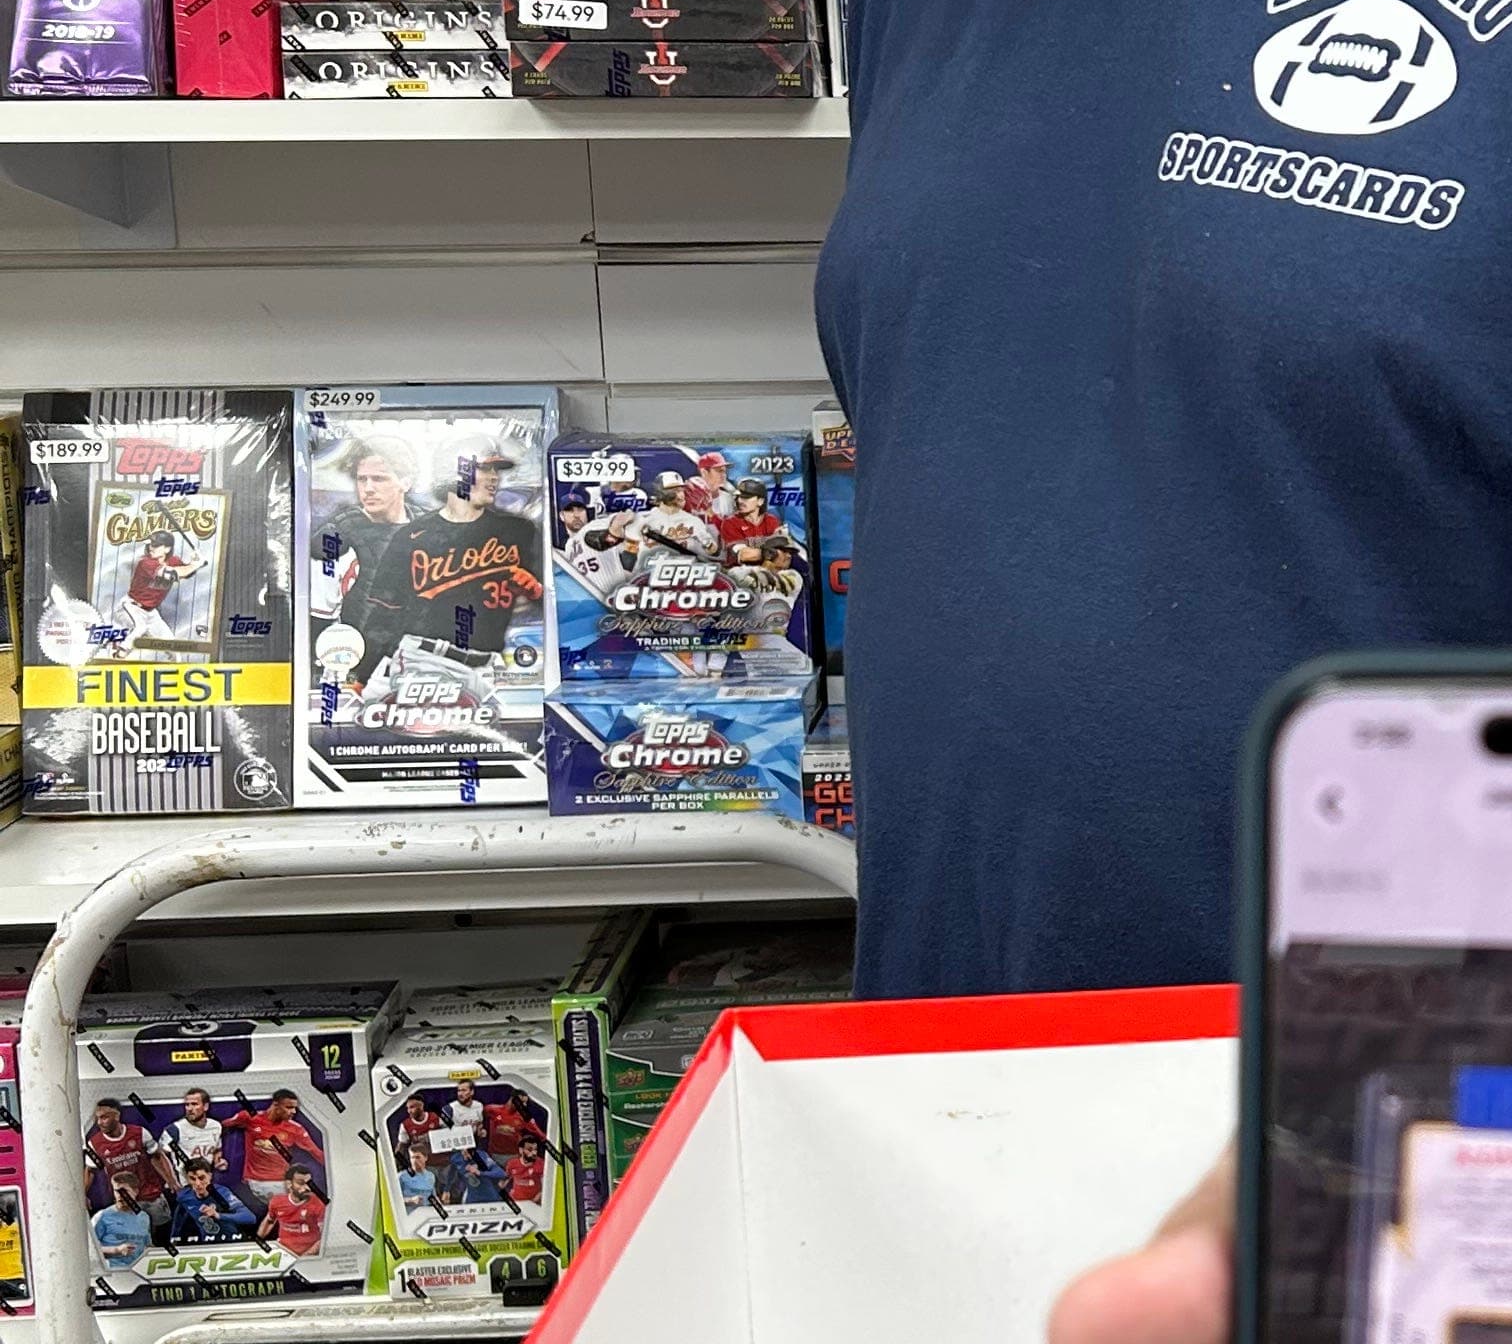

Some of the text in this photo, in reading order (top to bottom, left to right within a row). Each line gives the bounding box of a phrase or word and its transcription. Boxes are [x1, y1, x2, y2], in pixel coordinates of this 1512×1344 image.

[315, 10, 492, 32] ORIGINS
[531, 1, 595, 23] $74.99
[42, 23, 115, 41] 2018-19
[1160, 132, 1465, 231] SPORTSCARDS
[309, 391, 376, 409] $249.99
[36, 441, 102, 459] $189.99
[115, 437, 207, 477] Topps
[562, 460, 629, 478] $379.99
[750, 457, 795, 474] 2023
[153, 477, 201, 499] Topps
[106, 508, 218, 546] GAMERS
[410, 536, 522, 591] Orioles
[644, 559, 714, 588] Topps
[482, 580, 514, 610] 35
[614, 586, 752, 613] Chrome
[229, 614, 272, 637] Topps
[636, 637, 689, 647] TRADING
[77, 667, 243, 704] FINEST
[394, 670, 463, 705] Topps
[363, 702, 495, 730] Chrome
[91, 711, 221, 755] BASEBALL
[643, 715, 710, 745] Topps
[335, 745, 380, 757] CHROME
[381, 744, 446, 757] AUTOGRAPH
[449, 743, 477, 756] CARD
[479, 742, 501, 755] PER
[610, 743, 743, 769] Chrome
[575, 791, 780, 805] 2 EXCLUSIVE SAPPHIRE PARALLELS
[651, 802, 704, 812] PER BOX
[320, 1043, 341, 1071] 12
[427, 1219, 524, 1237] PRIZM
[146, 1253, 283, 1275] PRIZM
